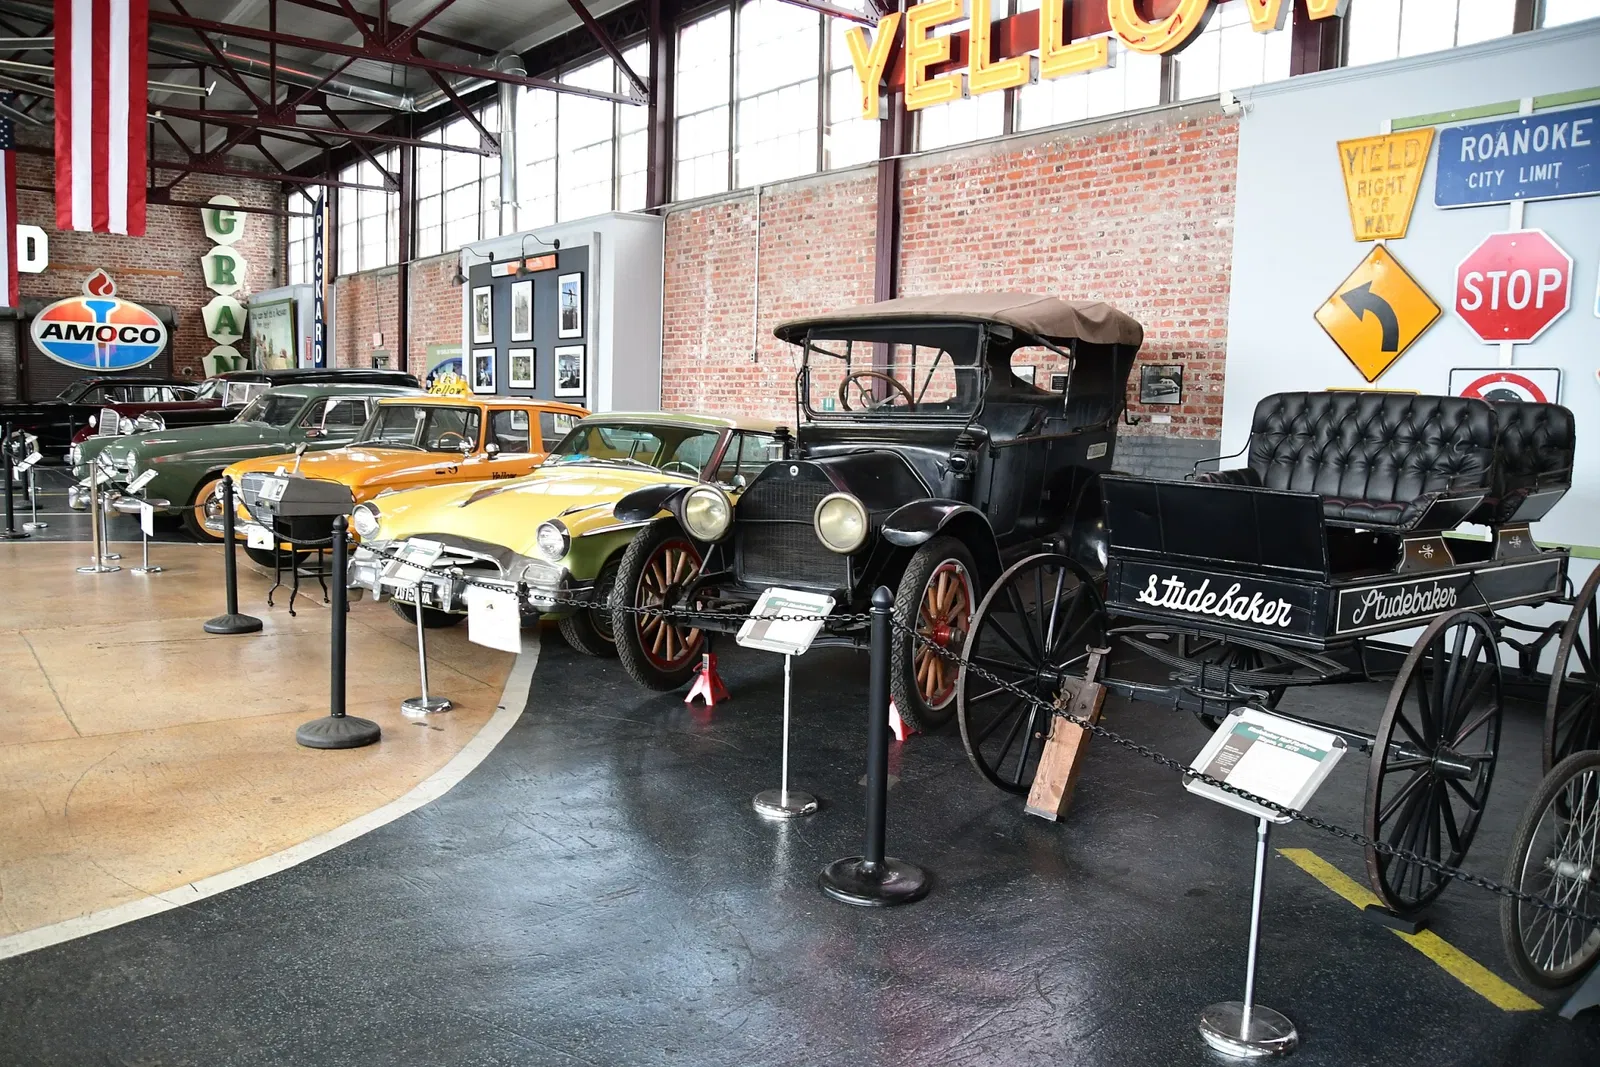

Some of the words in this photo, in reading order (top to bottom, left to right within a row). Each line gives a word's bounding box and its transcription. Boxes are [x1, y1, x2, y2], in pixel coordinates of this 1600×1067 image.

[845, 0, 1338, 119] YELLO
[1344, 138, 1422, 175] YIELD
[1460, 118, 1593, 162] ROANOKE
[1357, 174, 1405, 198] RIGHT
[1468, 169, 1505, 188] CITY
[1519, 162, 1563, 183] LIMIT
[1364, 214, 1396, 233] WAY
[1370, 197, 1388, 213] OF
[315, 215, 323, 363] PACKARD
[1460, 268, 1562, 311] STOP
[40, 324, 161, 343] AMOCO
[430, 384, 465, 395] Yellow
[1135, 573, 1292, 627] Studebaker
[1352, 580, 1457, 624] Studebaker
